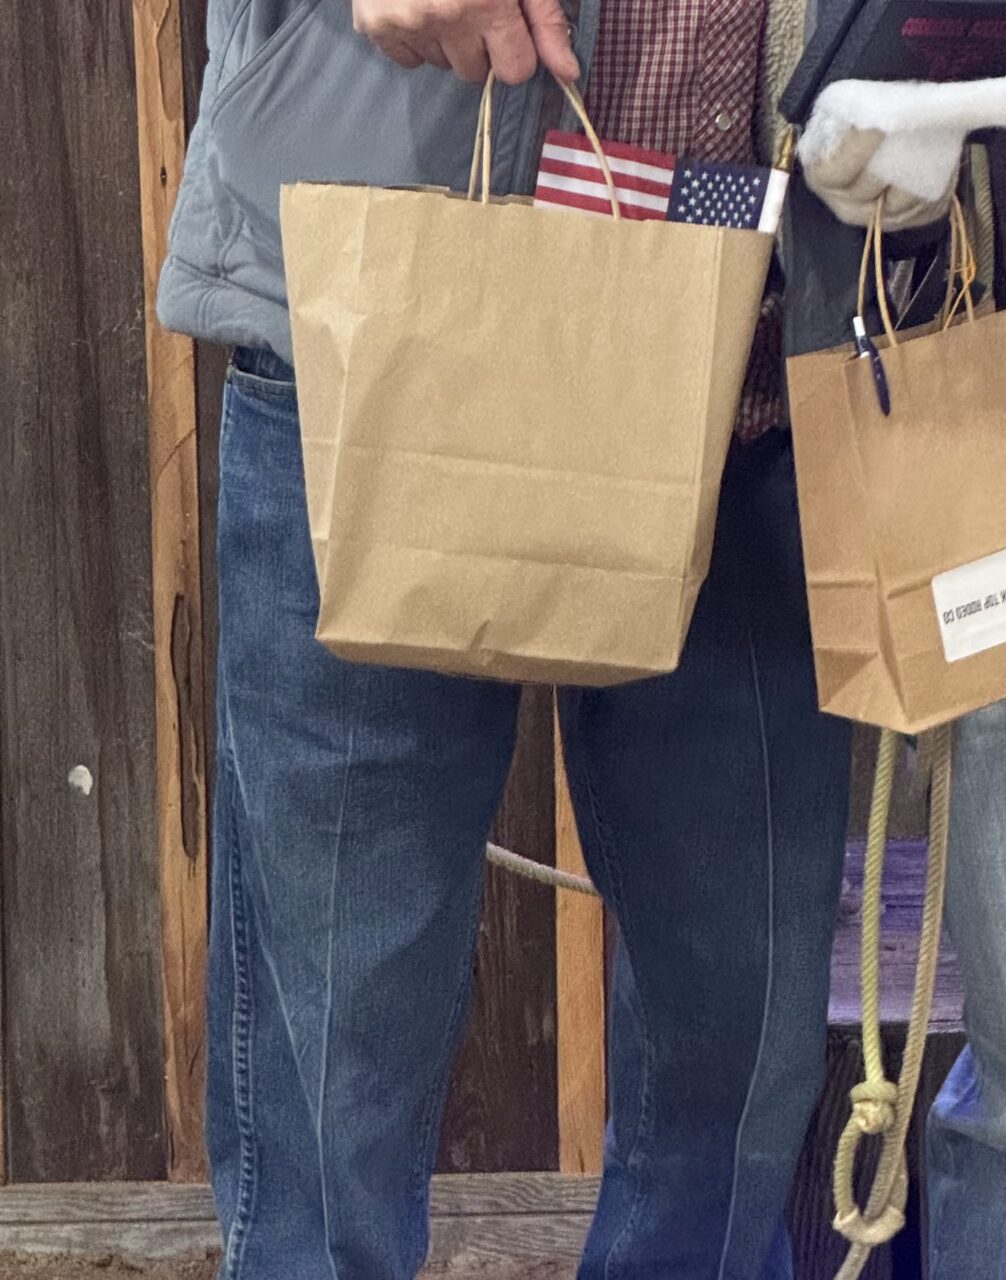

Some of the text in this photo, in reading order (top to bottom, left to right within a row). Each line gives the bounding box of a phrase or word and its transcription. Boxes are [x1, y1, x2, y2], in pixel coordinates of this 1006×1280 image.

[955, 598, 983, 620] RODEO
[984, 592, 1000, 610] TOP
[942, 608, 955, 624] CO
